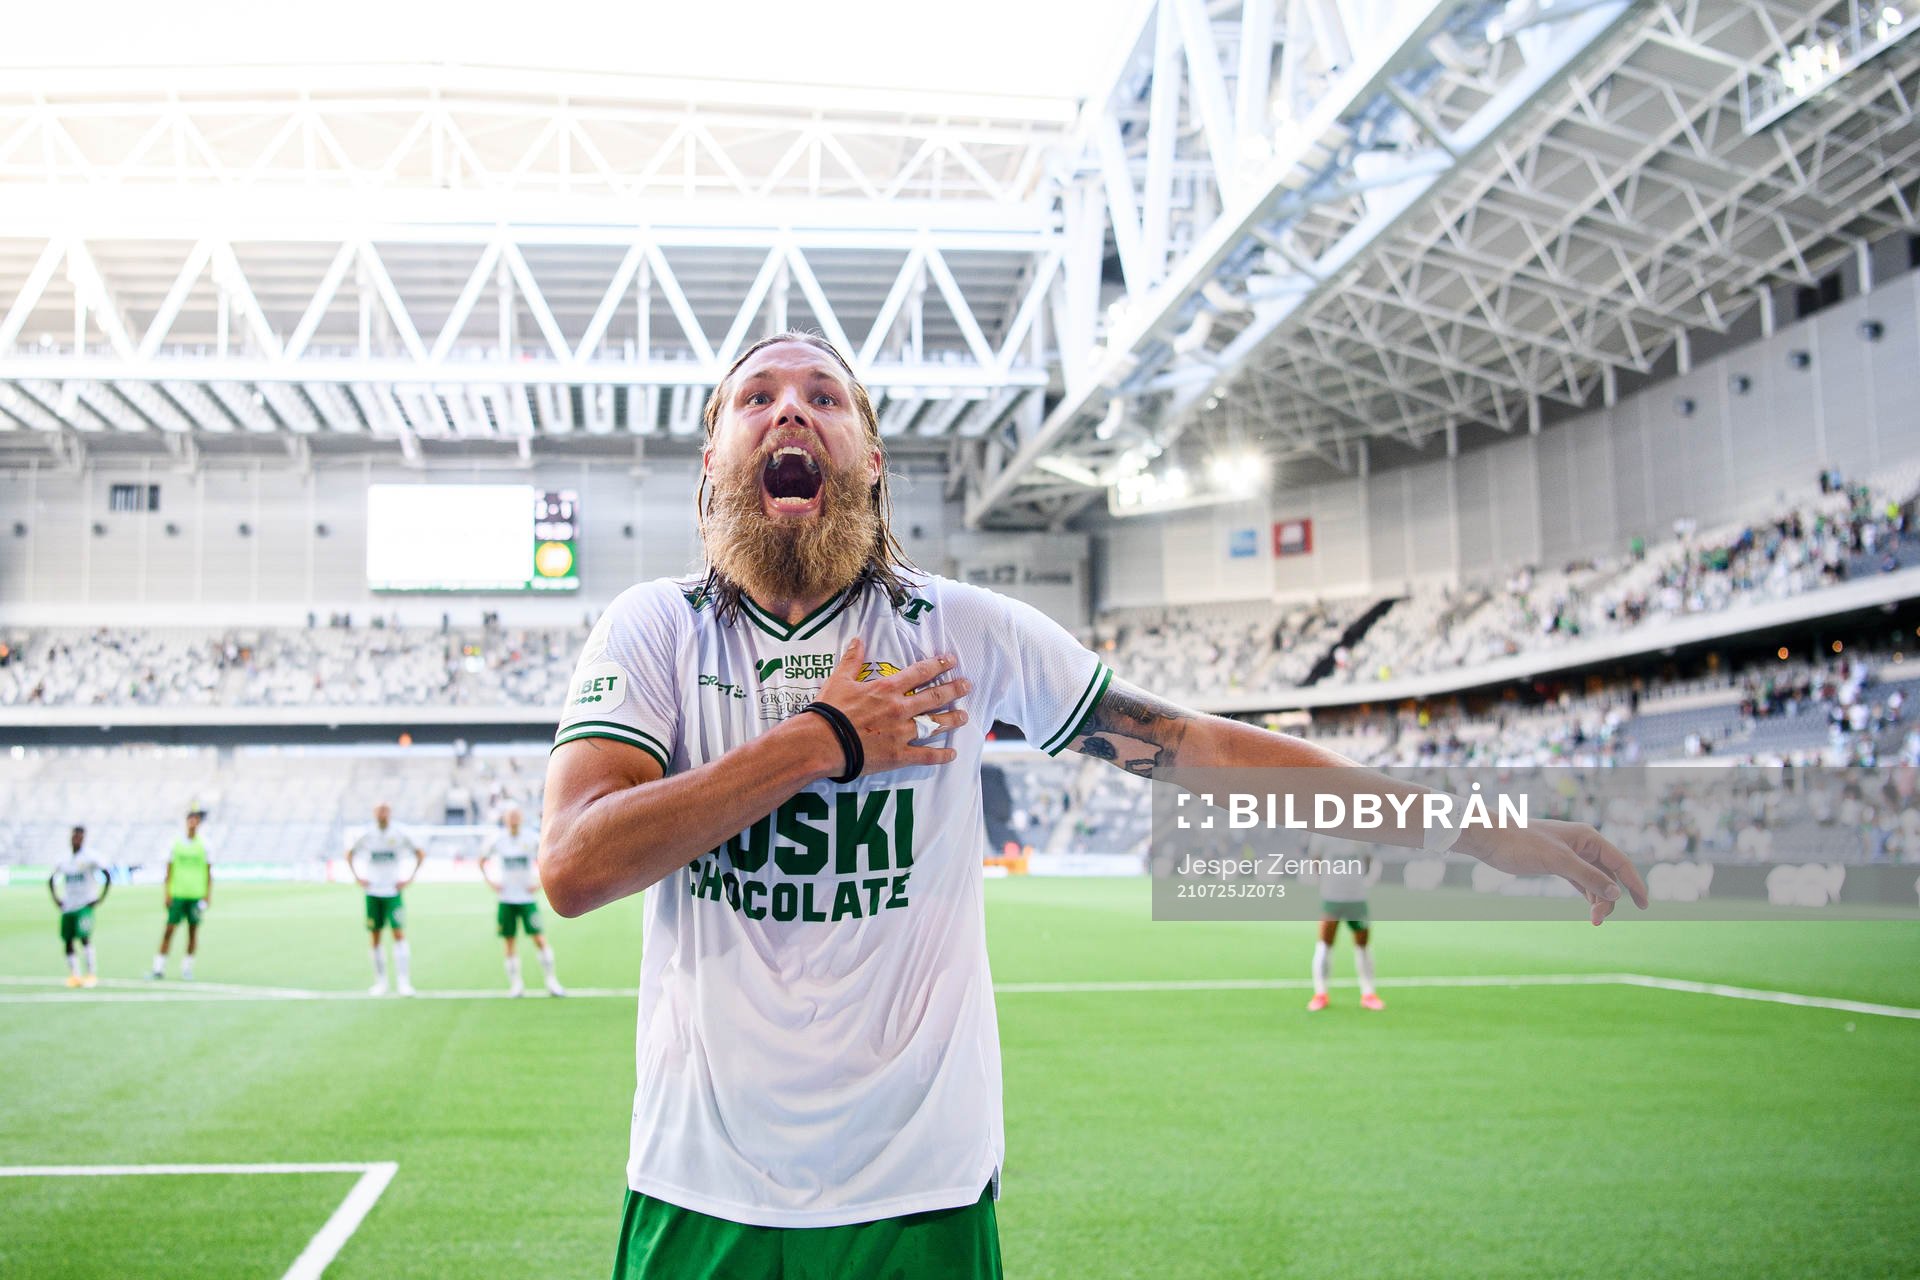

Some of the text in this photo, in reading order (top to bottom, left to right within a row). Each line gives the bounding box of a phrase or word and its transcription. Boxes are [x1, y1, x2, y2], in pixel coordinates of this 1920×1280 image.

[785, 653, 834, 667] INTER
[785, 666, 834, 680] SPORT
[576, 676, 618, 695] BET
[708, 788, 914, 876] USKI
